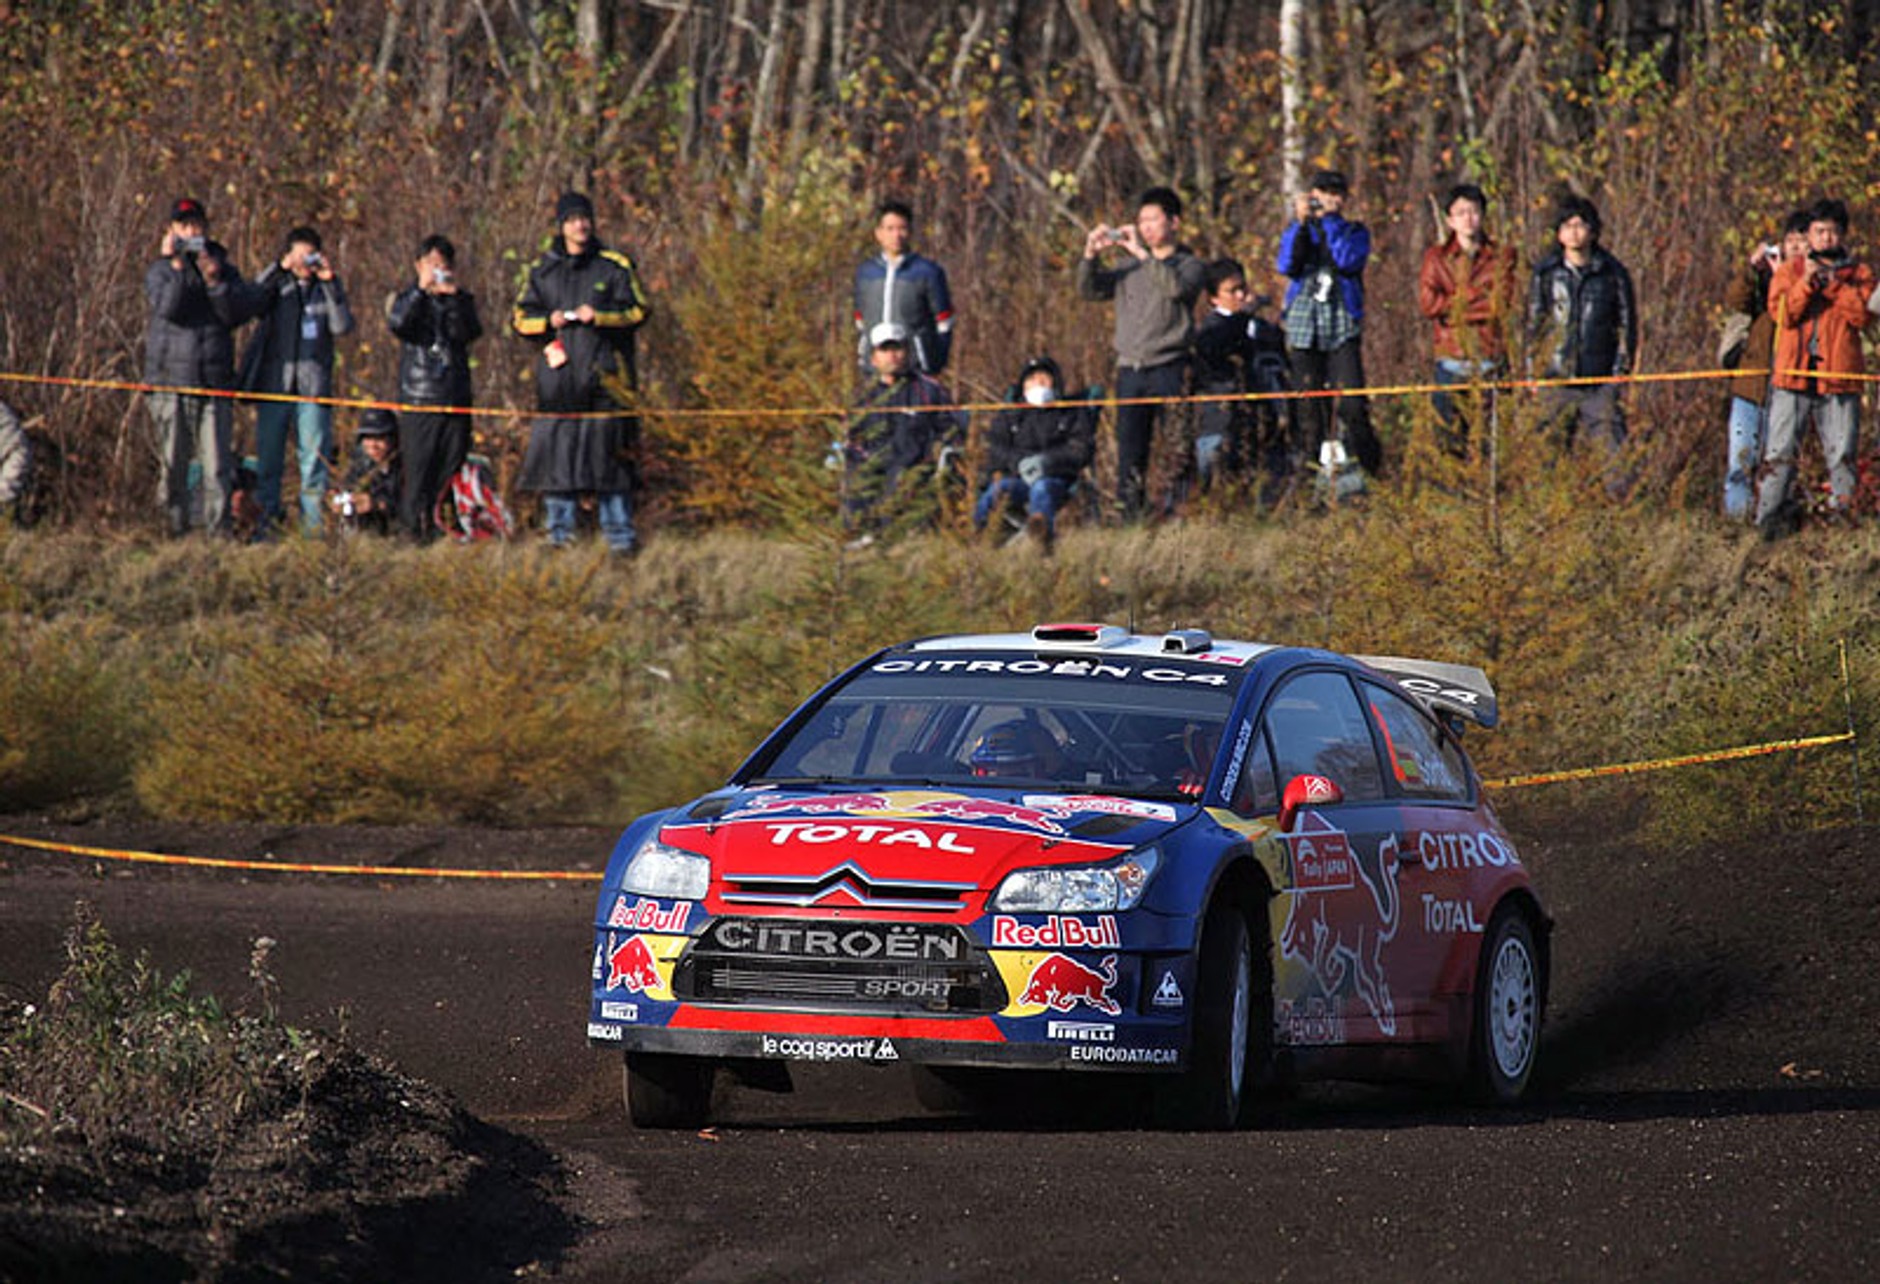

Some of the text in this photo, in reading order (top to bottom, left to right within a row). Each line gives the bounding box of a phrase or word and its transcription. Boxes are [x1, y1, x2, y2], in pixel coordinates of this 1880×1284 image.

[1141, 669, 1229, 687] C4
[1397, 678, 1479, 705] C4
[765, 822, 976, 854] TOTAL
[636, 900, 693, 932] Bull
[1421, 893, 1485, 933] TOTAL
[714, 921, 959, 959] CITROËN
[993, 915, 1120, 947] Red Bull
[864, 979, 954, 997] SPORT
[1047, 1020, 1115, 1041] PIRELLI
[762, 1034, 875, 1062] le coq sportif
[1070, 1045, 1180, 1064] EURODATACAR
